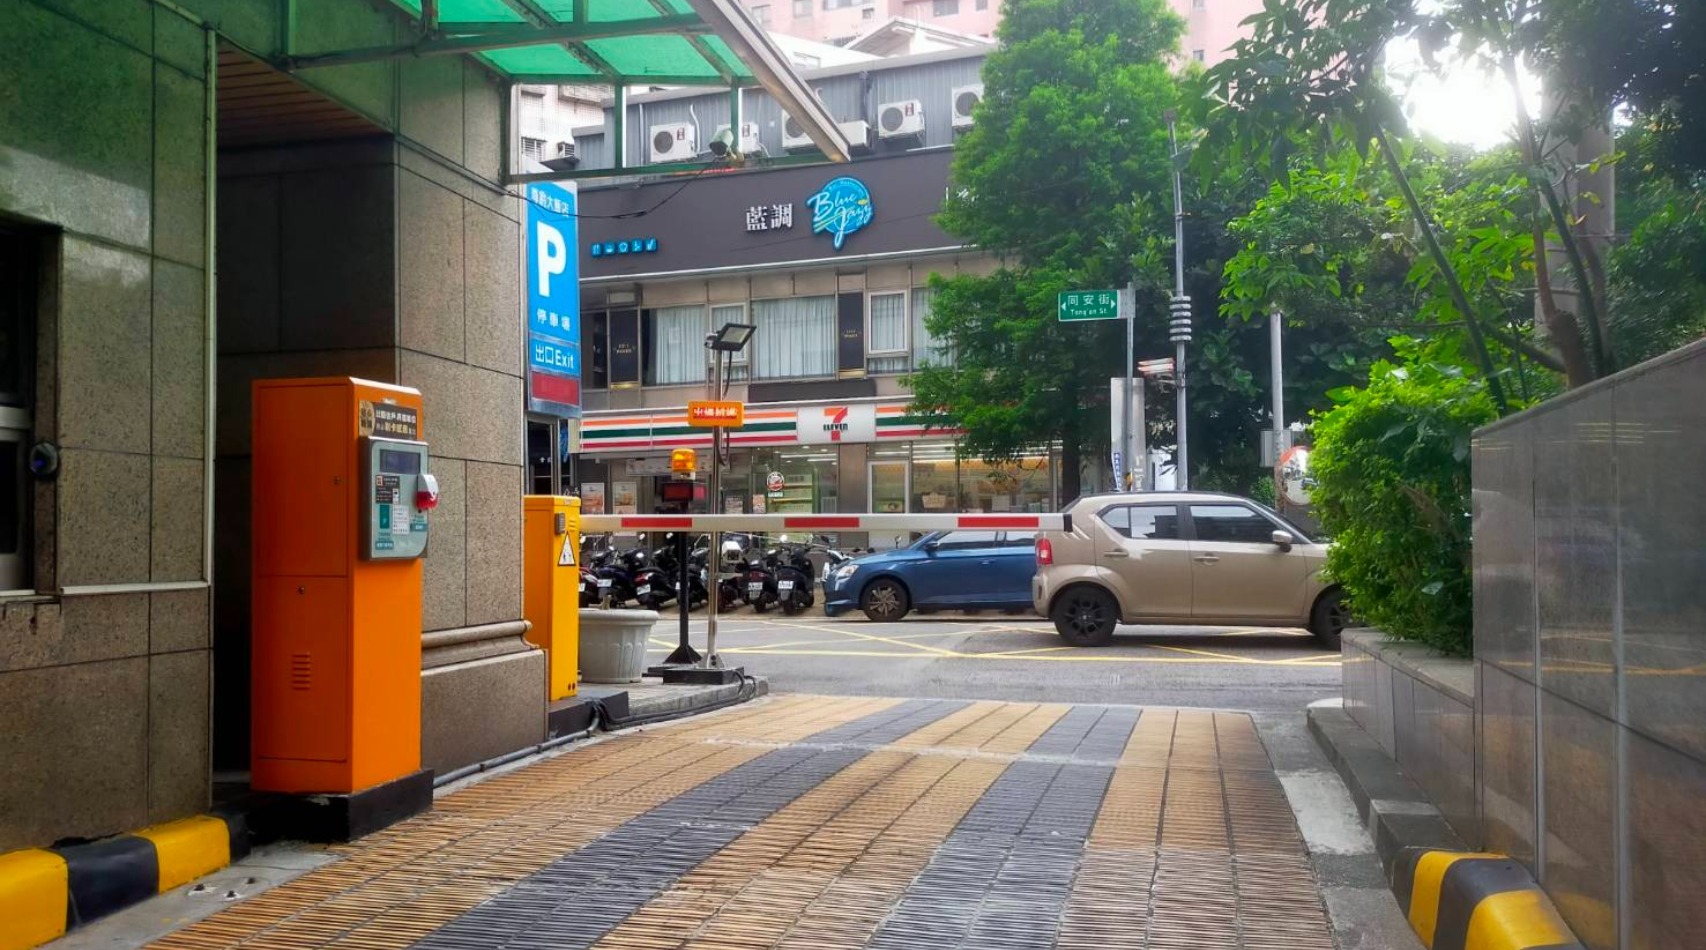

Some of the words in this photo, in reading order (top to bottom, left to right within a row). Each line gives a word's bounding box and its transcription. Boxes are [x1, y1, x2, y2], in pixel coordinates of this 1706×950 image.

[745, 203, 793, 231] 藍調
[806, 190, 857, 222] Blue
[536, 220, 567, 297] P
[1067, 294, 1110, 306] 同安街
[536, 308, 571, 332] 停車場
[535, 343, 554, 365] 出口
[555, 349, 574, 369] Exit
[823, 406, 848, 442] 7
